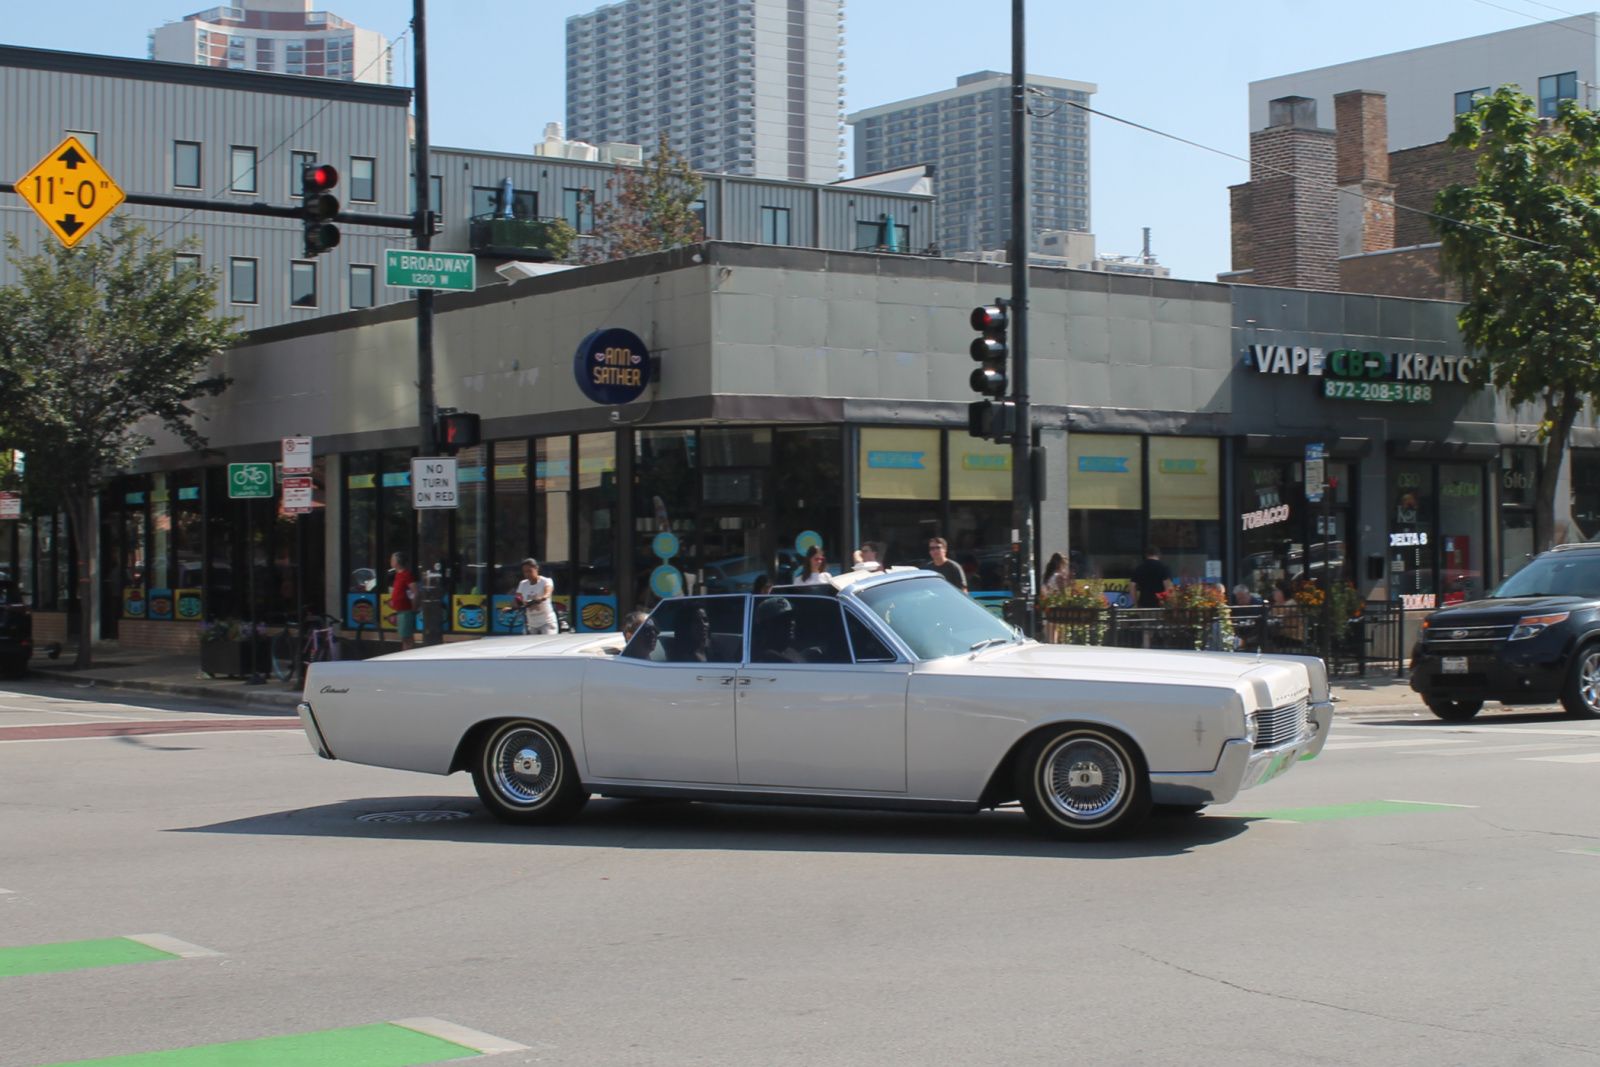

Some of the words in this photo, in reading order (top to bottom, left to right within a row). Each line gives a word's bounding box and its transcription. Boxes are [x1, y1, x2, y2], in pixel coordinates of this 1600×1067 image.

[389, 257, 397, 267] N
[400, 256, 470, 273] BROADWAY
[412, 273, 436, 285] 1200
[440, 275, 449, 285] W
[605, 347, 631, 366] ANN
[1254, 343, 1324, 376] VAPE
[1397, 352, 1496, 384] KRATO
[593, 366, 641, 386] SATHER
[1325, 380, 1433, 401] 872-208-3188
[426, 464, 444, 475] NO
[422, 477, 449, 488] TURN
[417, 491, 432, 502] ON
[435, 491, 455, 502] RED
[1241, 504, 1290, 531] TOBACCO
[1390, 533, 1419, 547] DELTA
